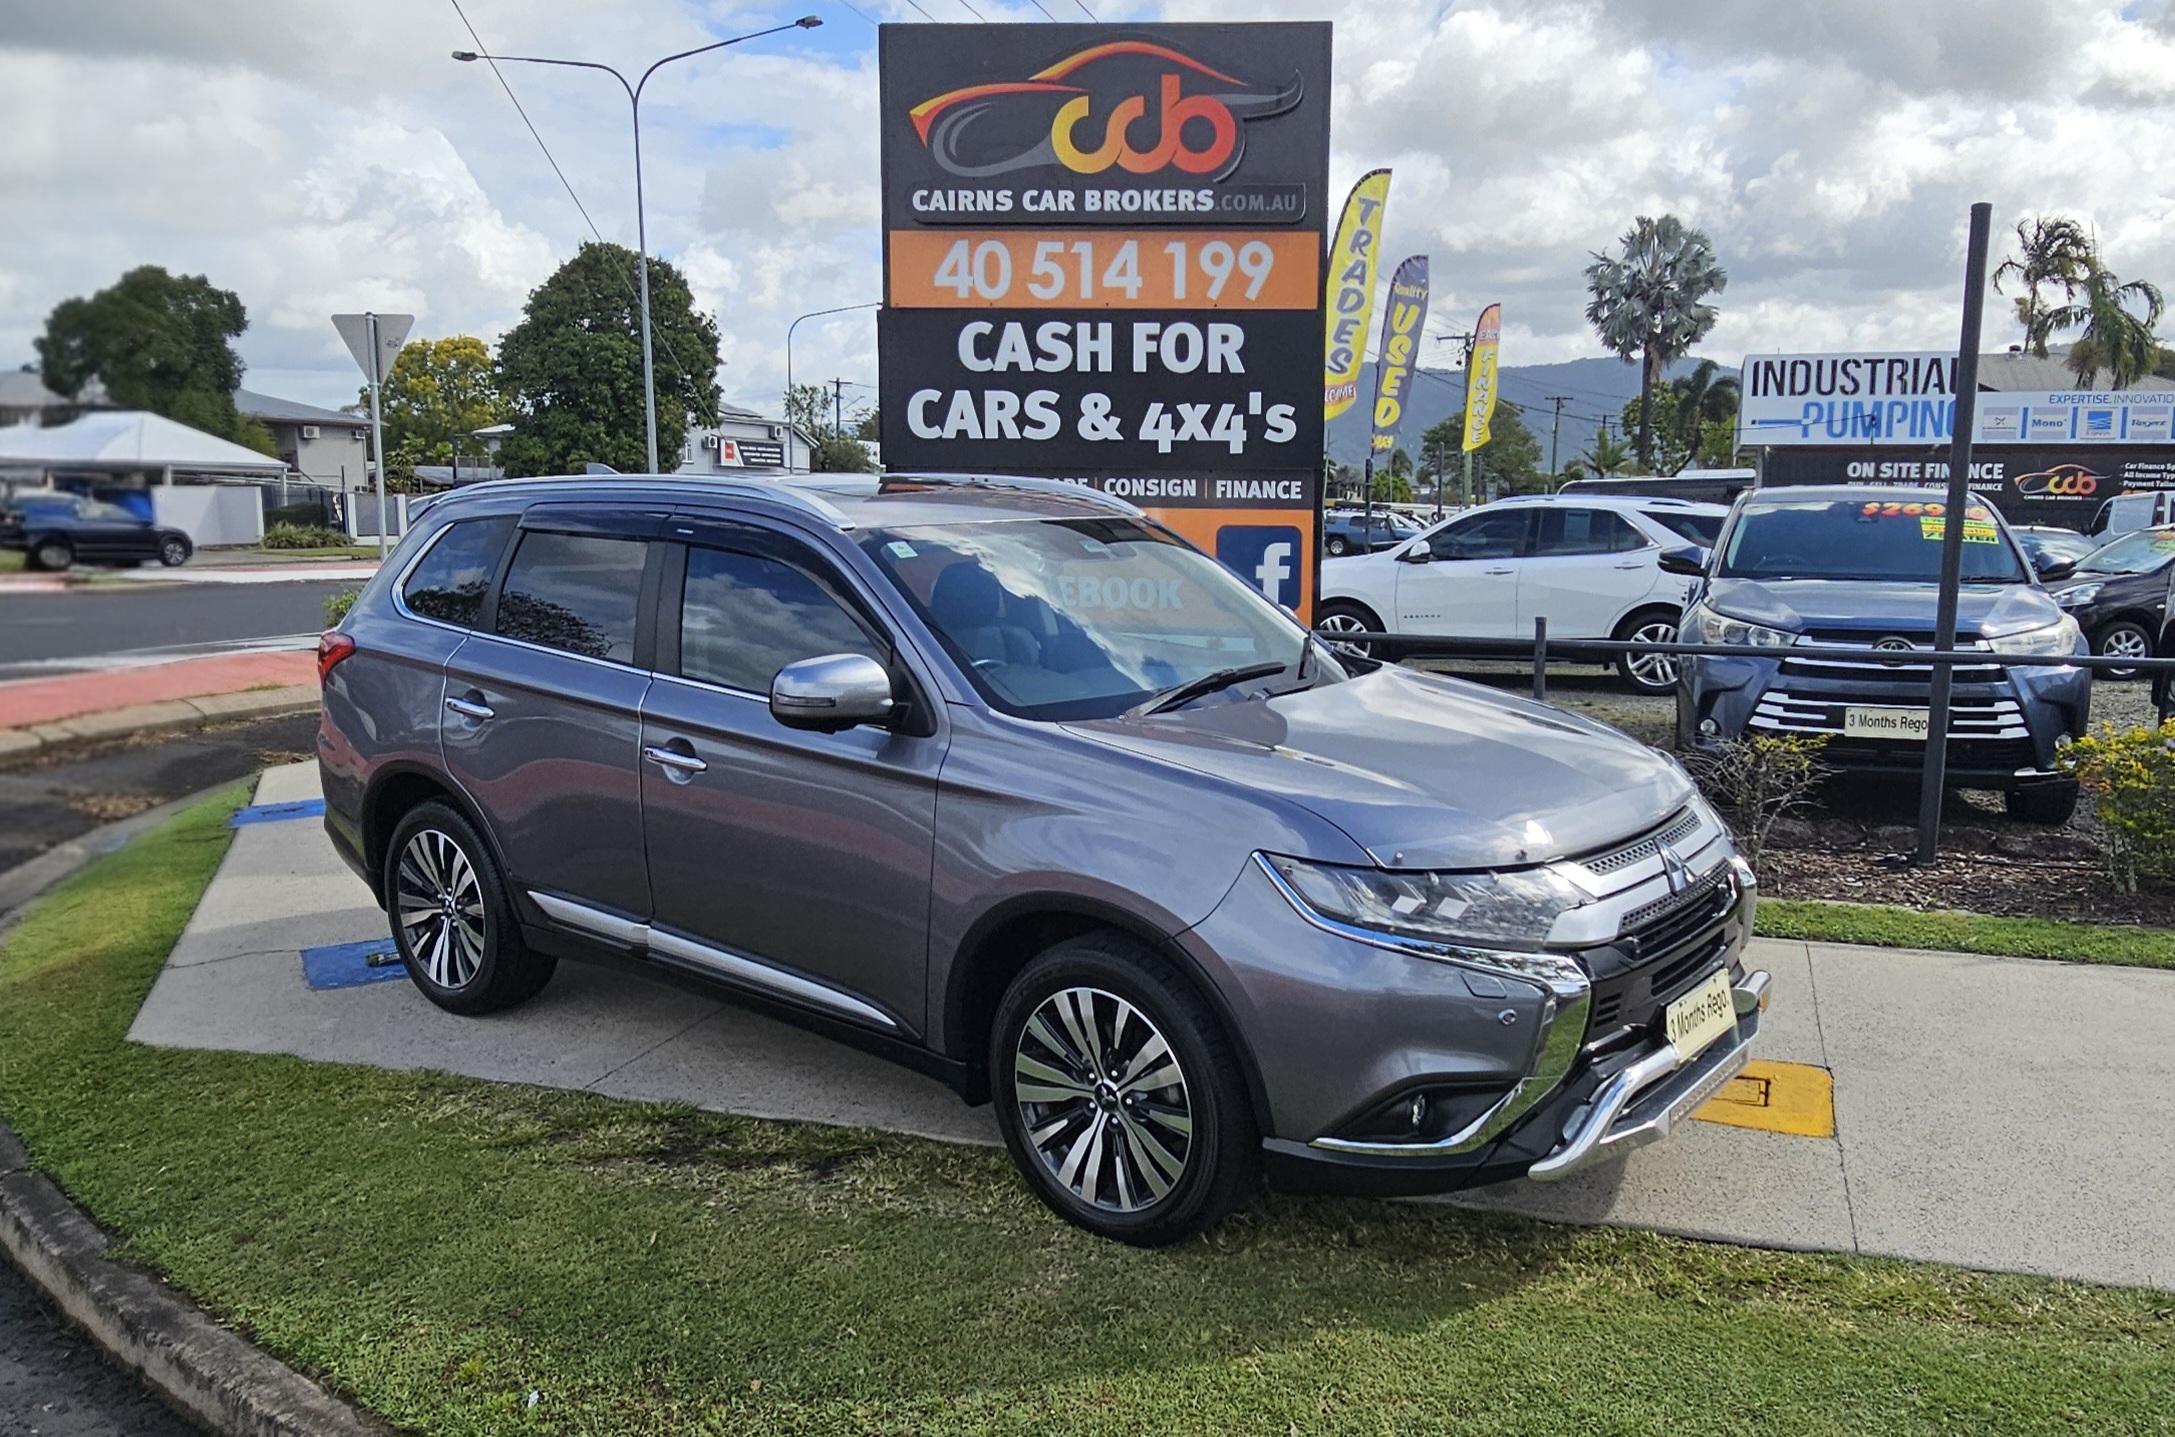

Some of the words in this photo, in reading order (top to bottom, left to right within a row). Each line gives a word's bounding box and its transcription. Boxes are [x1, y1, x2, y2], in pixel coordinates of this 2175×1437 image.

[912, 189, 1013, 212] CAIRNS
[1022, 190, 1075, 212] CAR
[934, 239, 1012, 300] 40
[1028, 240, 1143, 299] 514
[1164, 240, 1275, 301] 199
[1327, 197, 1381, 375] TRADES
[958, 321, 1113, 373] CASH
[1132, 322, 1246, 374] FOR
[1374, 302, 1420, 428] USED
[907, 389, 1061, 440] CARS
[1077, 393, 1124, 441] &
[1104, 478, 1197, 497] CONSIGN
[1216, 479, 1302, 499] FINANCE
[1847, 462, 1876, 479] ON
[1879, 463, 1922, 479] SITE
[1925, 462, 2005, 480] FINNCE
[1849, 715, 1855, 727] 3
[1858, 715, 1897, 729] Months
[1671, 1018, 1677, 1043] 3
[1677, 1003, 1706, 1037] Months
